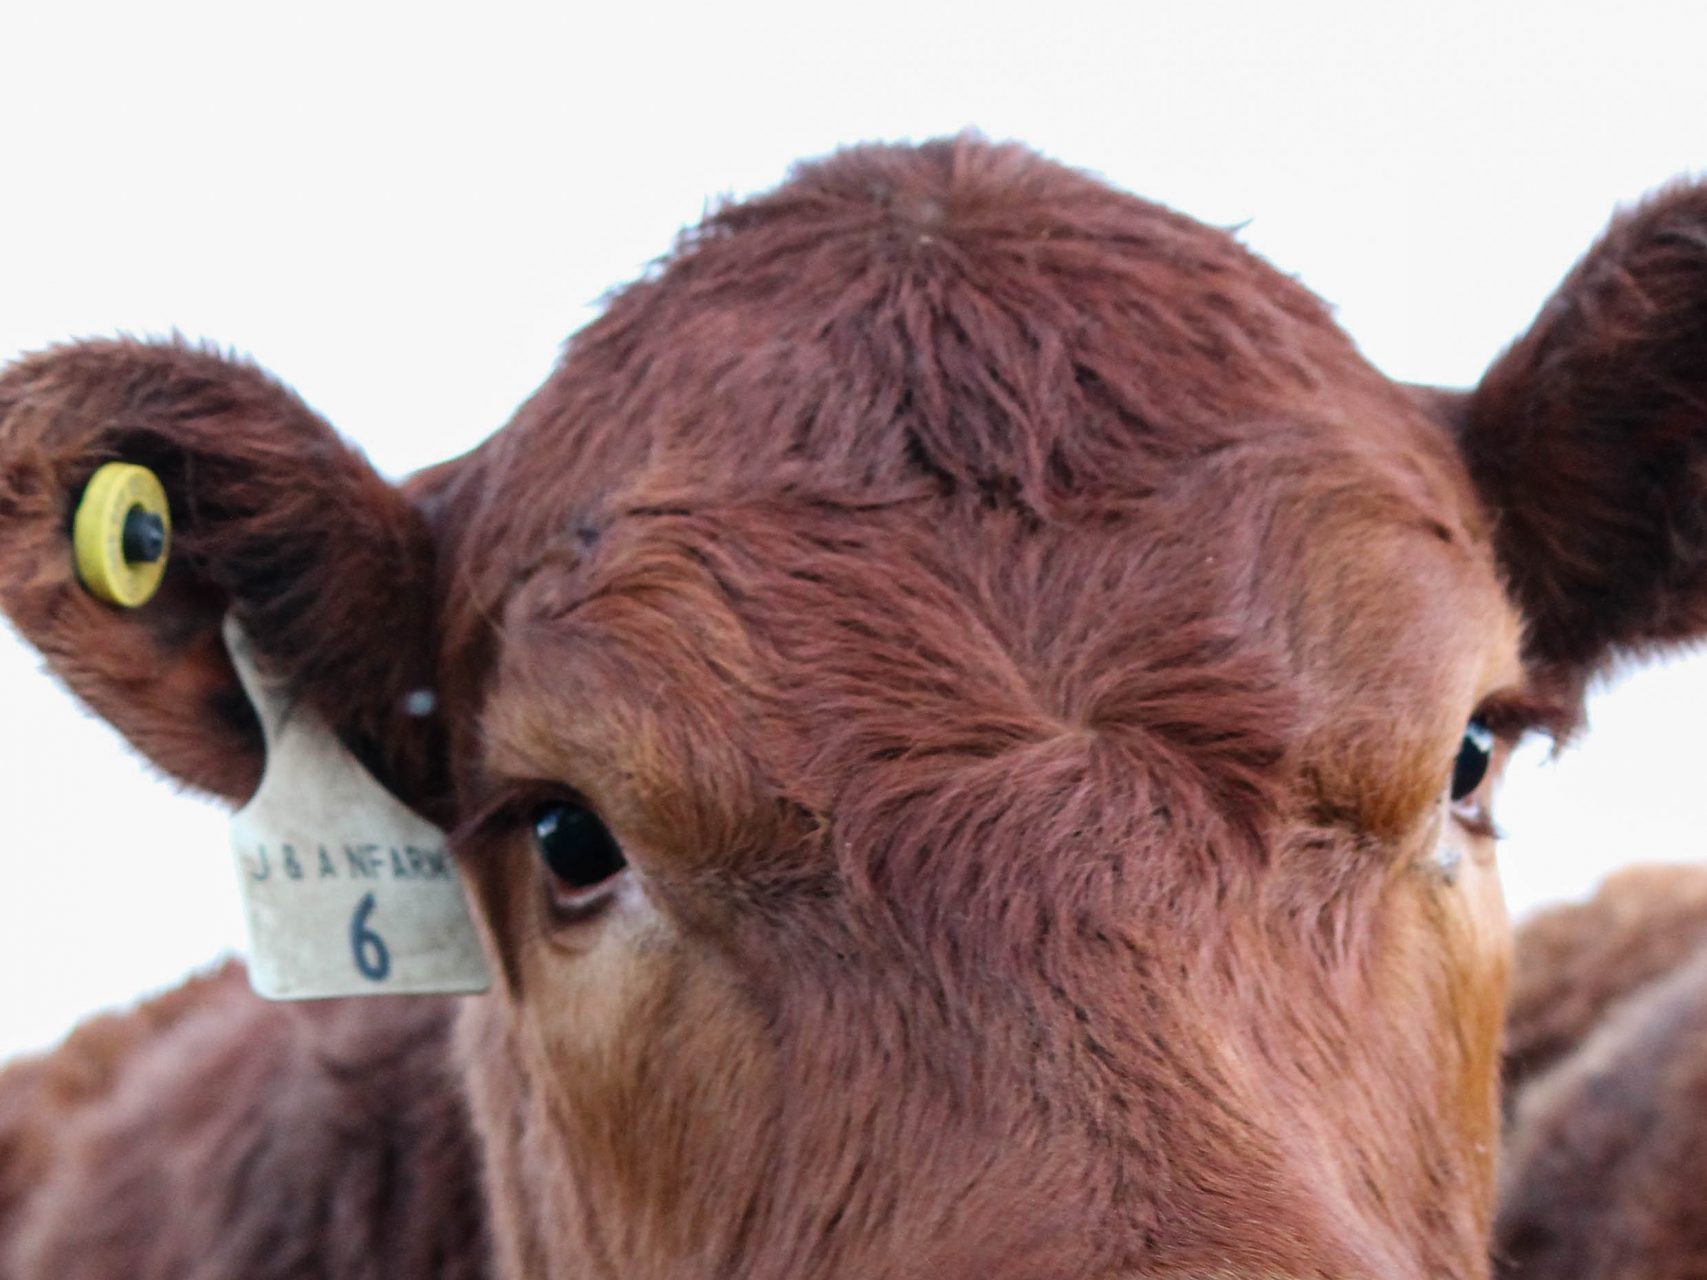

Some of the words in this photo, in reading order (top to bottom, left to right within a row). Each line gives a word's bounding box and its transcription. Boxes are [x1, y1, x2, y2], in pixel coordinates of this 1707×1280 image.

[252, 844, 270, 882] J
[318, 844, 338, 879] A
[350, 890, 391, 982] 6
